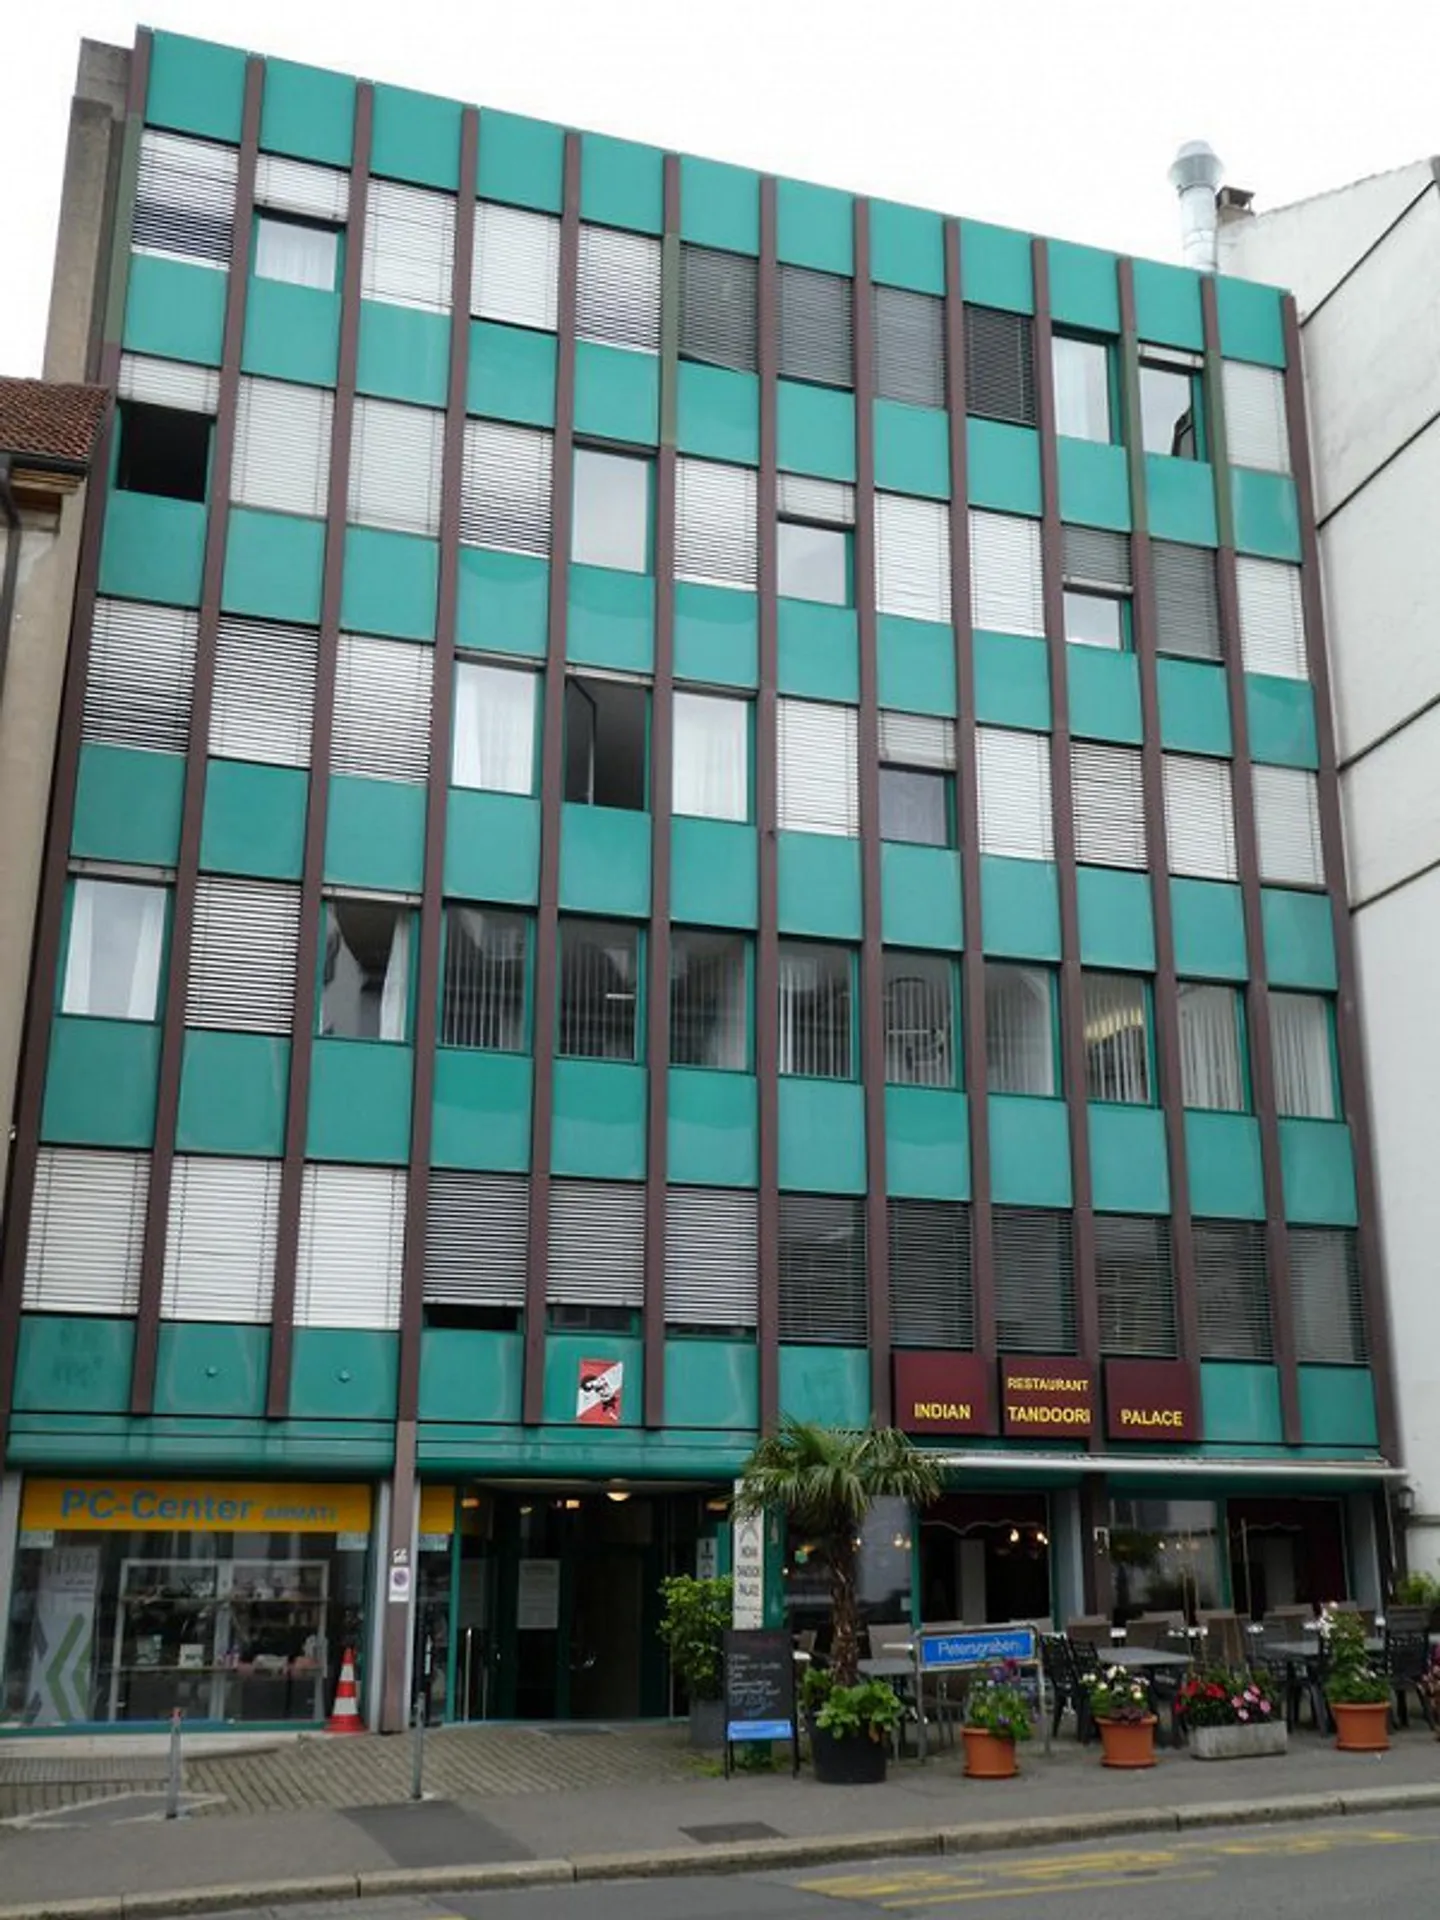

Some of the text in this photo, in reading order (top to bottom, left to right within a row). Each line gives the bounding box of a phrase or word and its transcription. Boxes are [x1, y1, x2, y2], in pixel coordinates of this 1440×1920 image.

[1007, 1377, 1089, 1391] RESTAURANT
[914, 1403, 1184, 1426] INDIAN TANDOORI PALACE
[61, 1488, 254, 1521] PC-Center
